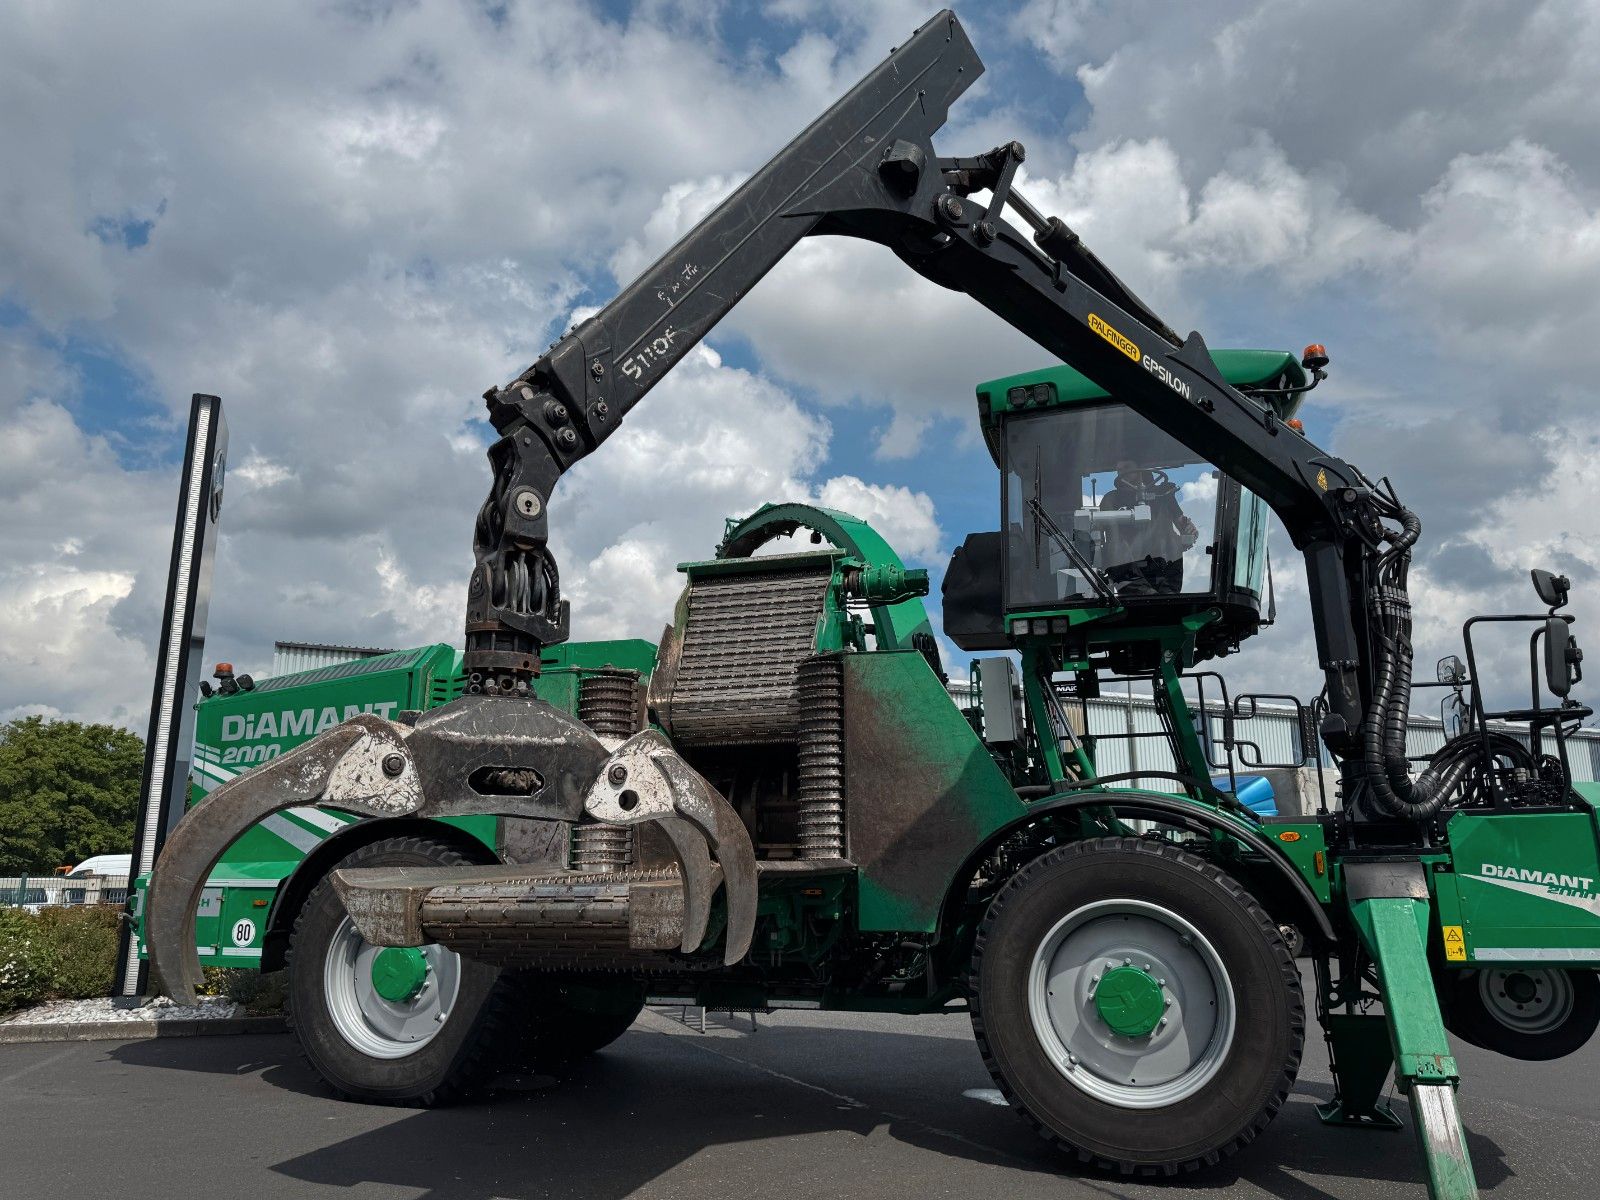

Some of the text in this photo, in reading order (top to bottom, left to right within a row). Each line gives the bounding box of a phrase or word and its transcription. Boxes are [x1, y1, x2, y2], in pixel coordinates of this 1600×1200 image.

[1091, 316, 1190, 399] PALFINGER EPSILON
[236, 923, 251, 941] 80
